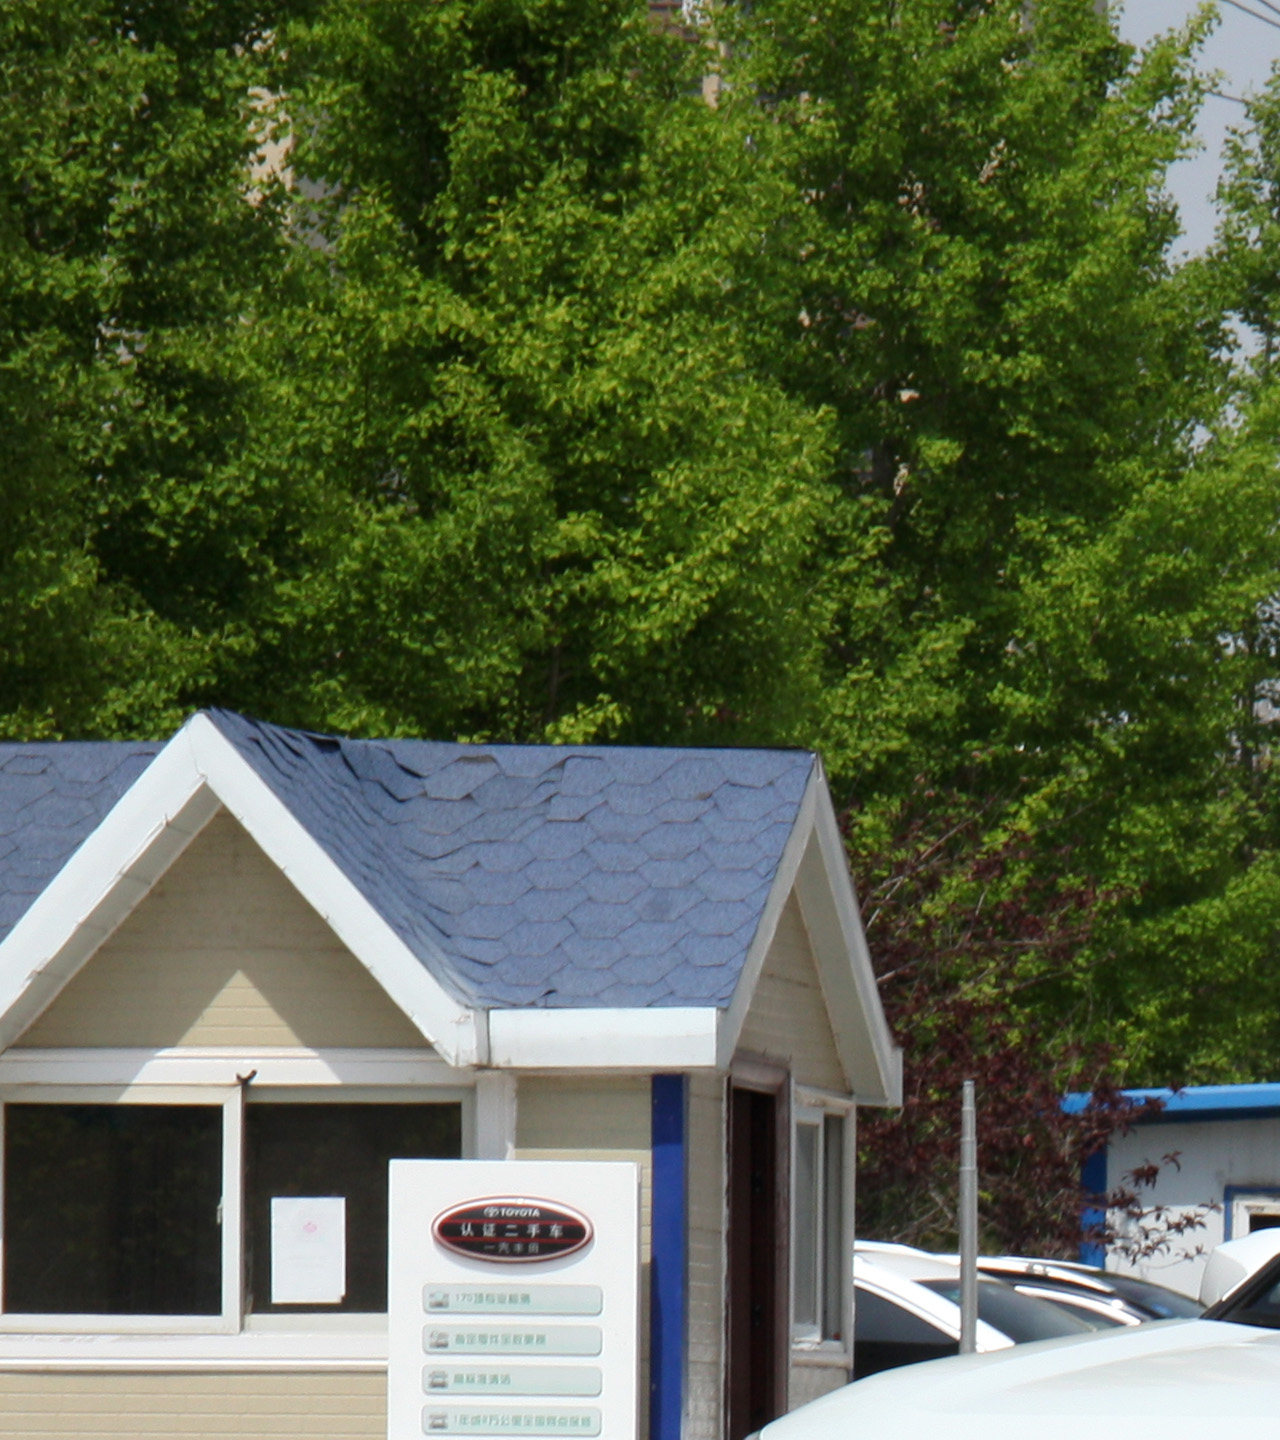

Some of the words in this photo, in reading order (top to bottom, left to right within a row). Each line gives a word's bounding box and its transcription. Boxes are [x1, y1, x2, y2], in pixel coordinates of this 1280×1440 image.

[500, 1207, 541, 1218] TOYOTA
[460, 1222, 564, 1239] 认证二手车
